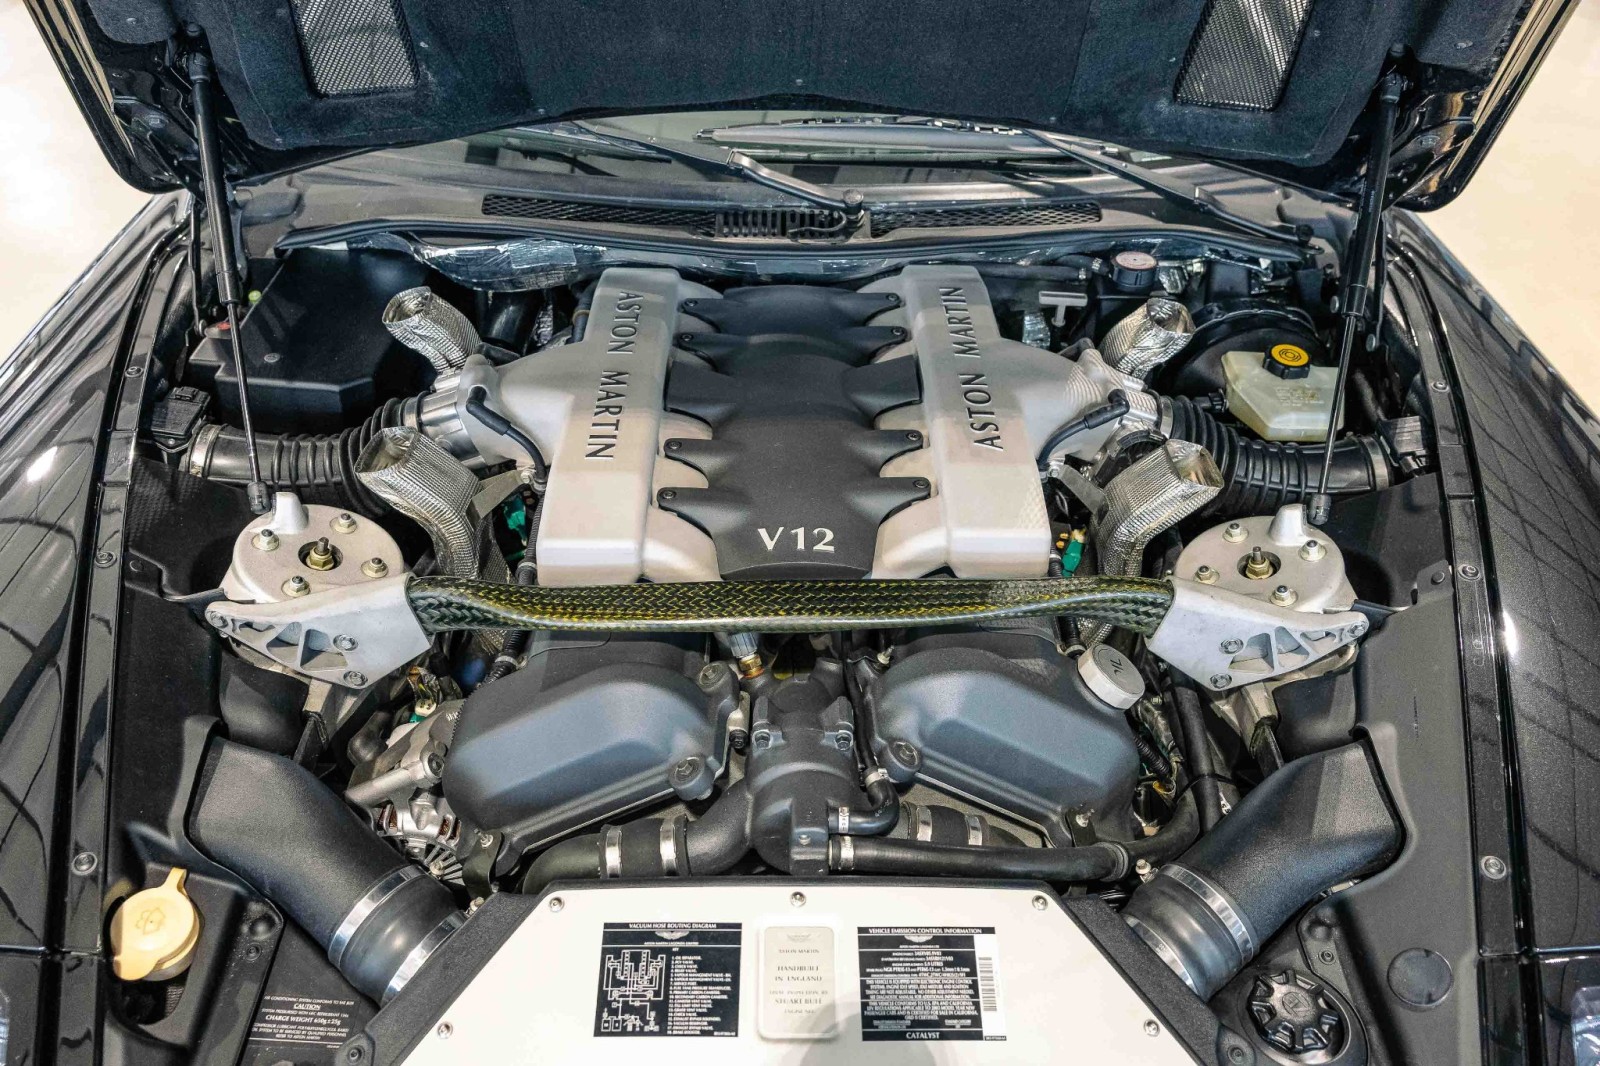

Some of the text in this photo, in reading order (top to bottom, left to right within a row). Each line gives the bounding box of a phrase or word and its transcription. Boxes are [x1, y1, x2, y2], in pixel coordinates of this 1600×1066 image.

[584, 291, 644, 460] ASTON MARTIN
[939, 286, 1004, 451] ASTON MARTIN
